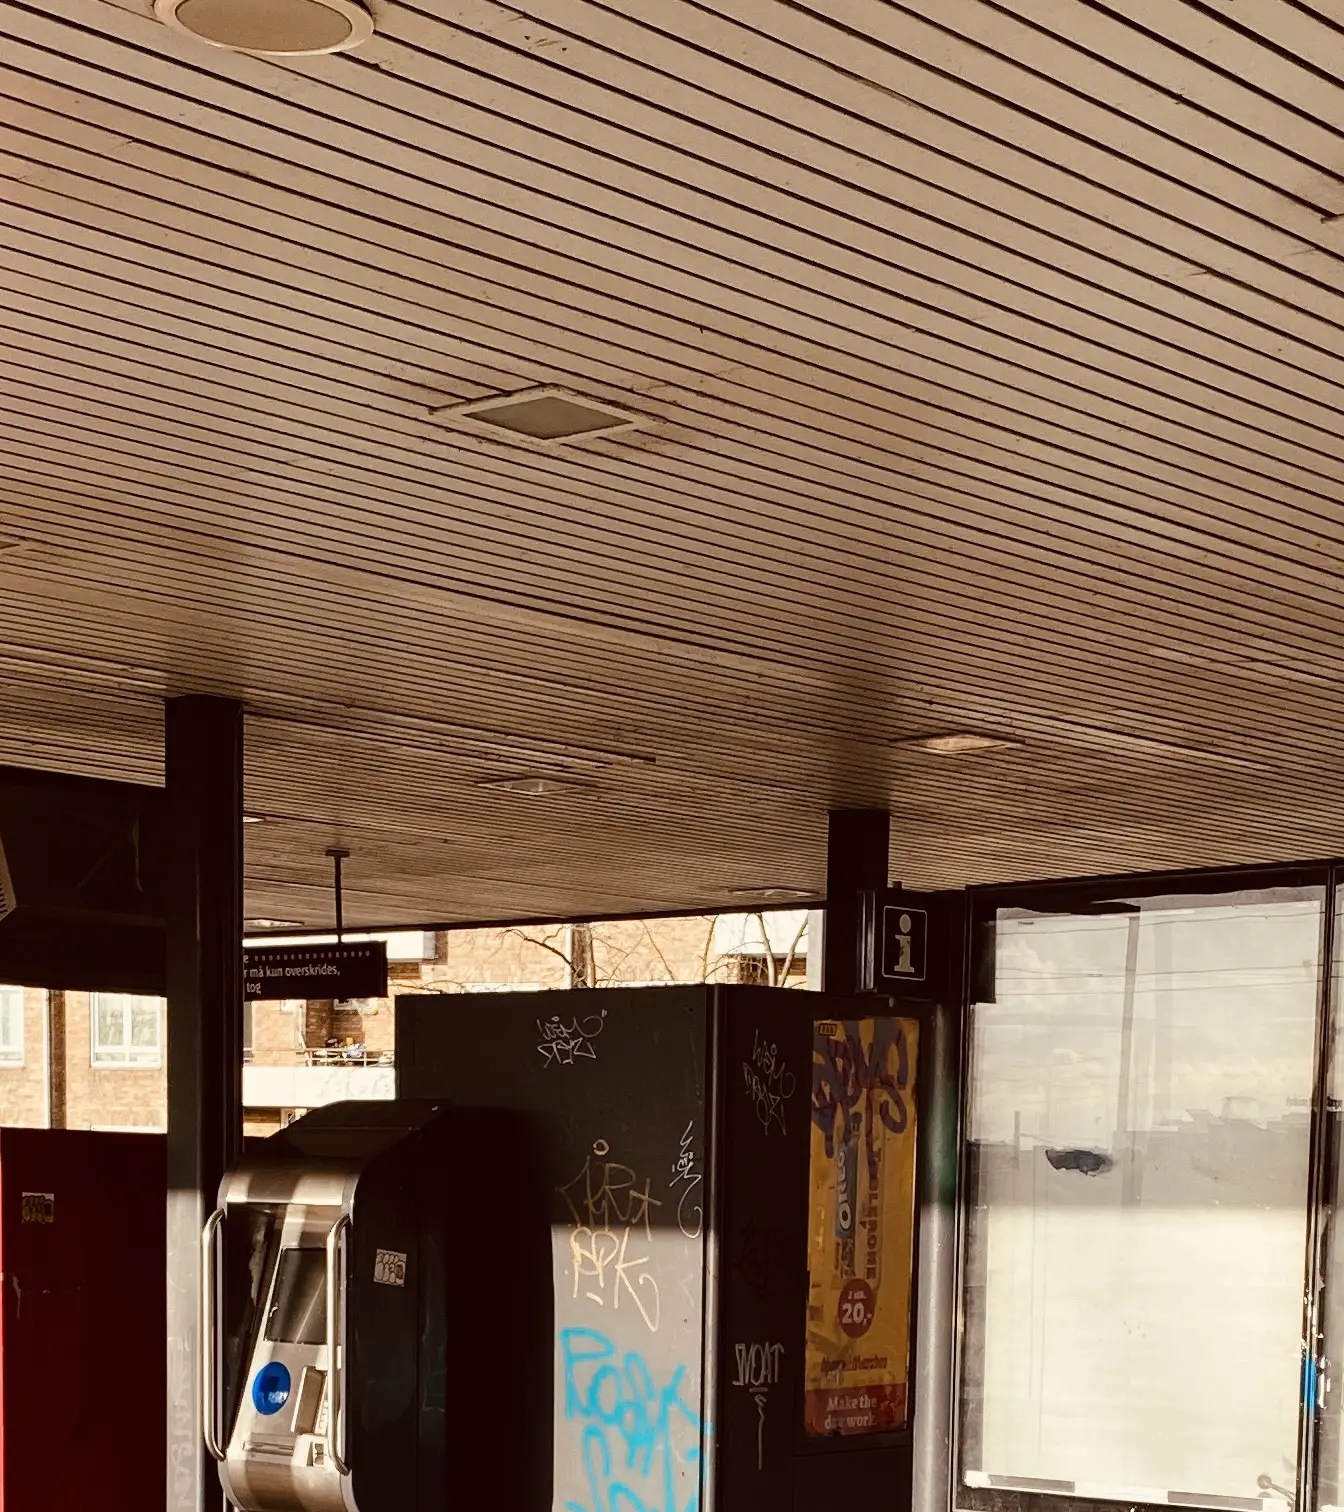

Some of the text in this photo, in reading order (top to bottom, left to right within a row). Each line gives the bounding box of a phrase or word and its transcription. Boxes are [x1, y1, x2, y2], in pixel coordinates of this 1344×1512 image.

[249, 966, 264, 978] må
[266, 966, 284, 978] kun
[285, 964, 341, 978] overskrides,
[246, 982, 262, 995] tog
[841, 1302, 873, 1327] 20,-
[827, 1395, 877, 1411] Make the
